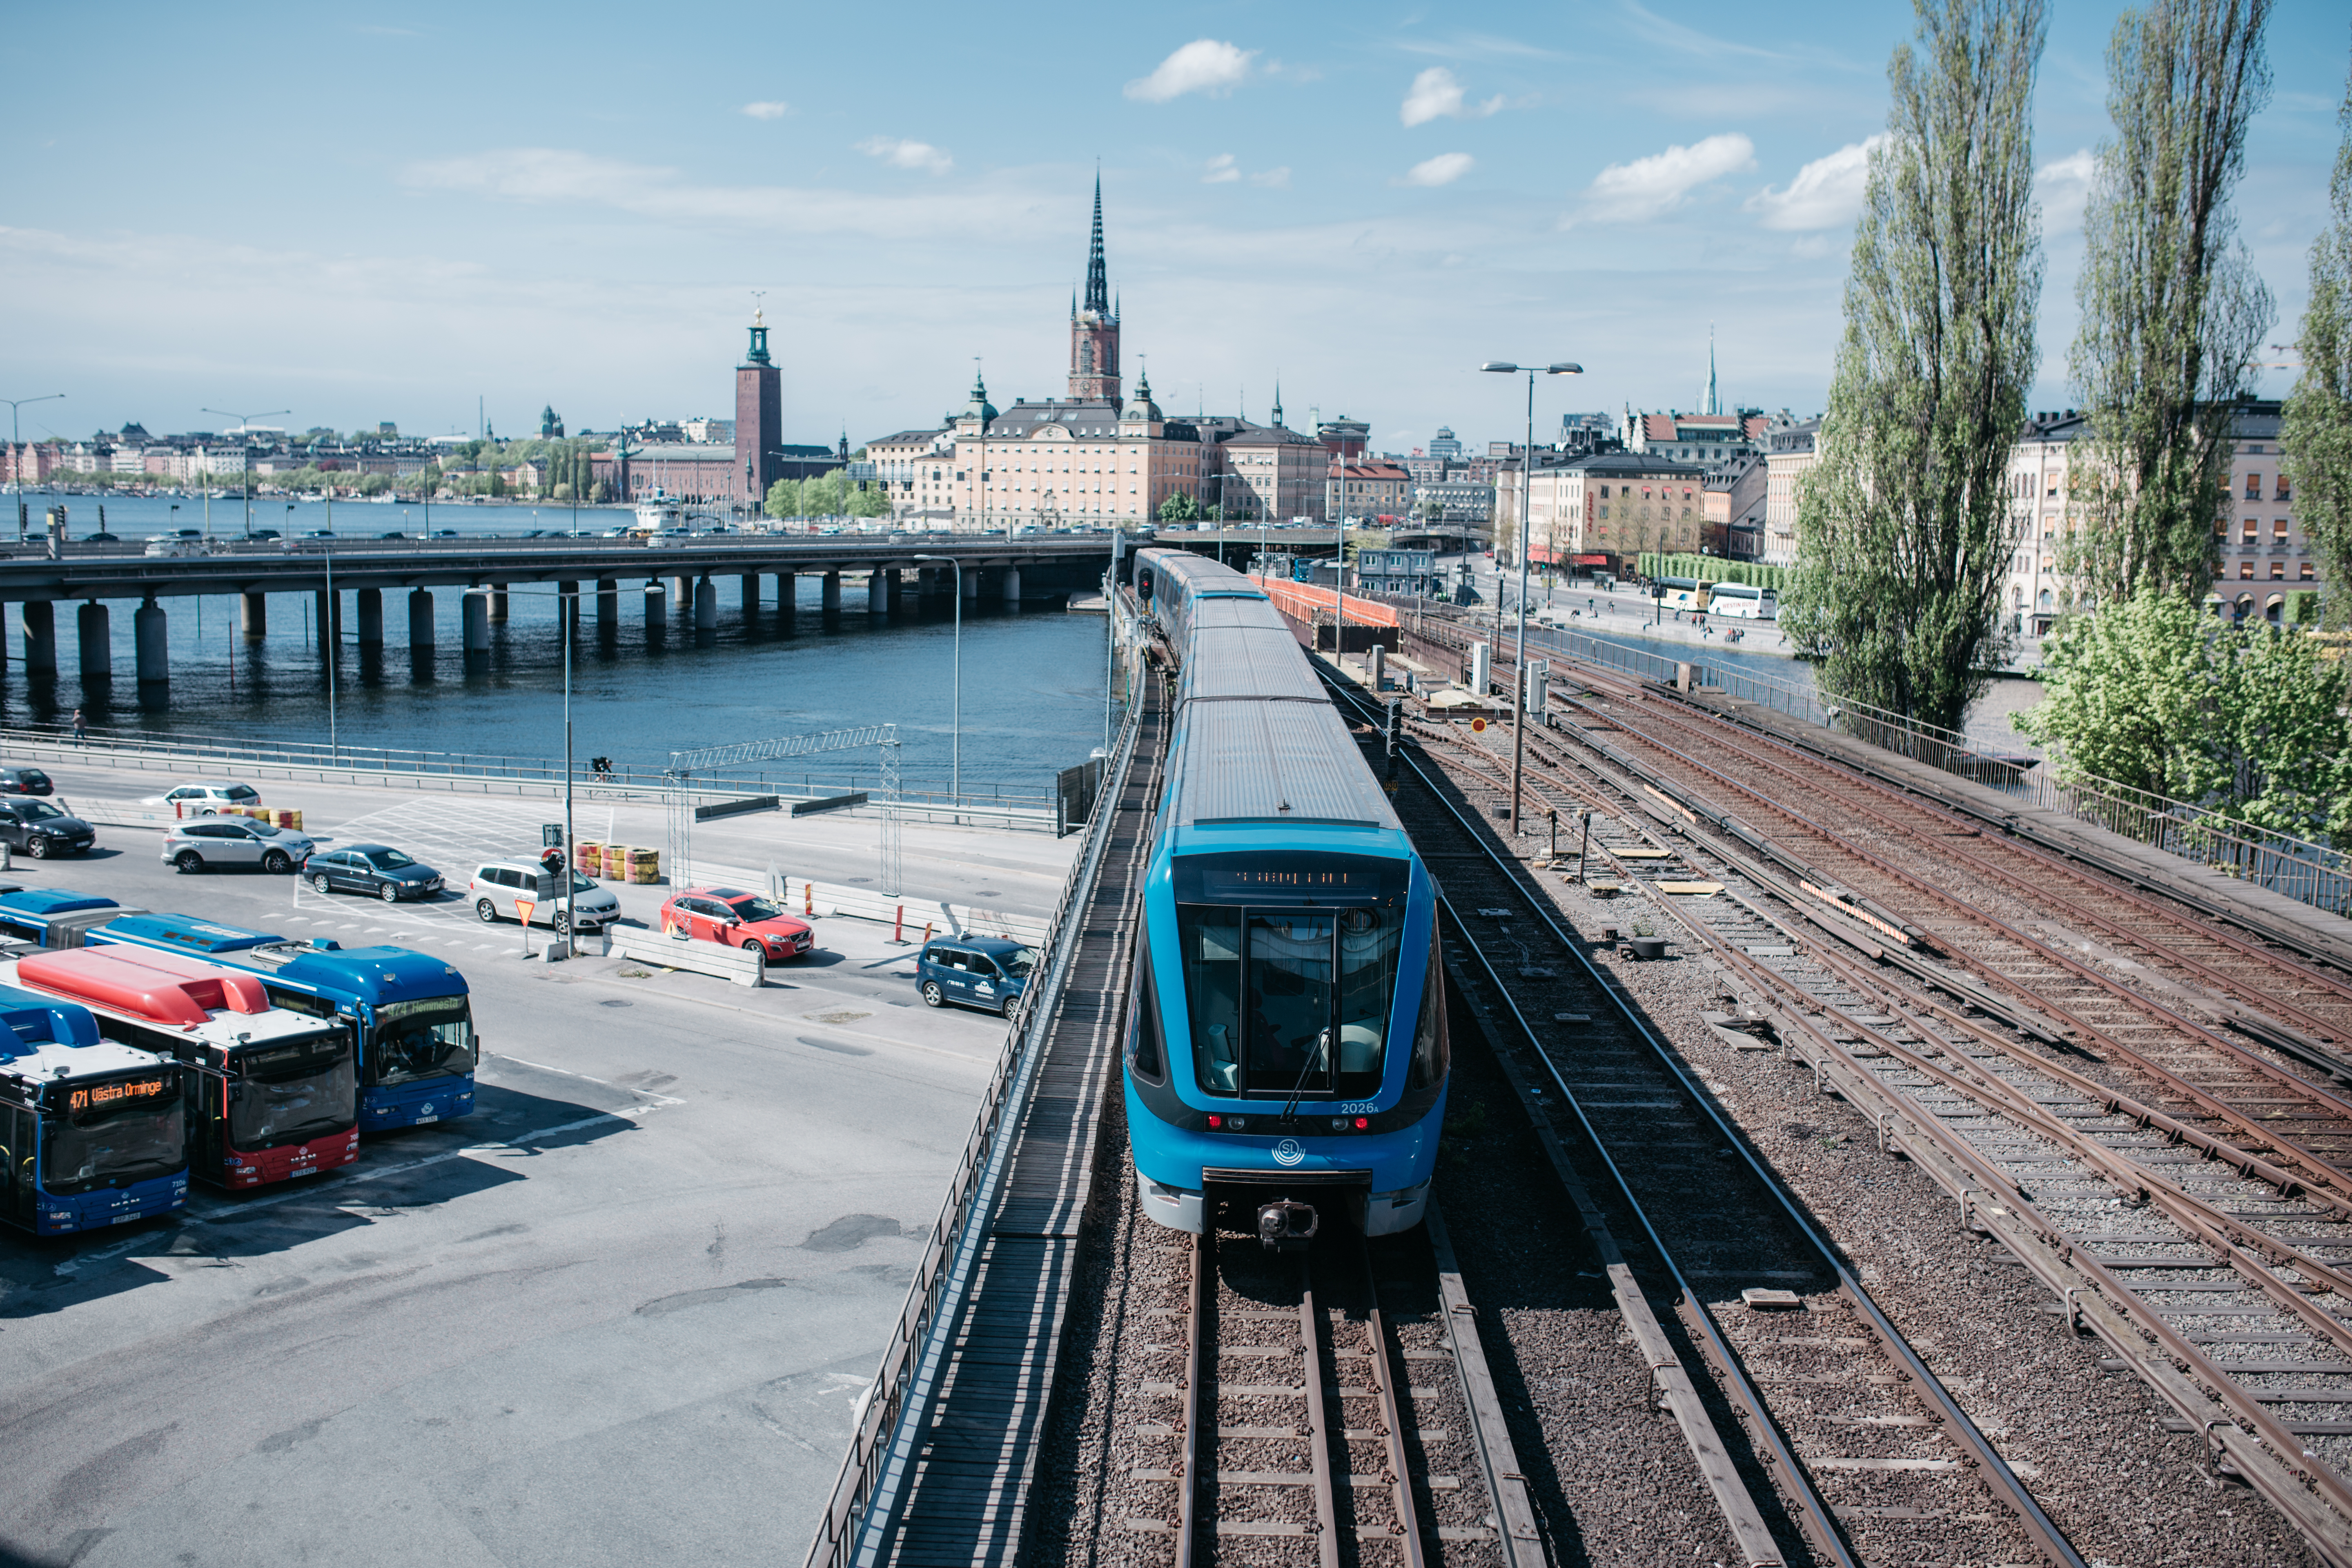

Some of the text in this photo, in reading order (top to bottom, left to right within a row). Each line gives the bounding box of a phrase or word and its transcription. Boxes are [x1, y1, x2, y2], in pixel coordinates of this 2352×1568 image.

[412, 998, 458, 1013] Hemmesta
[70, 1081, 162, 1109] 471 Västra Orminge
[290, 1153, 316, 1164] MAN
[172, 1179, 186, 1187] 7106
